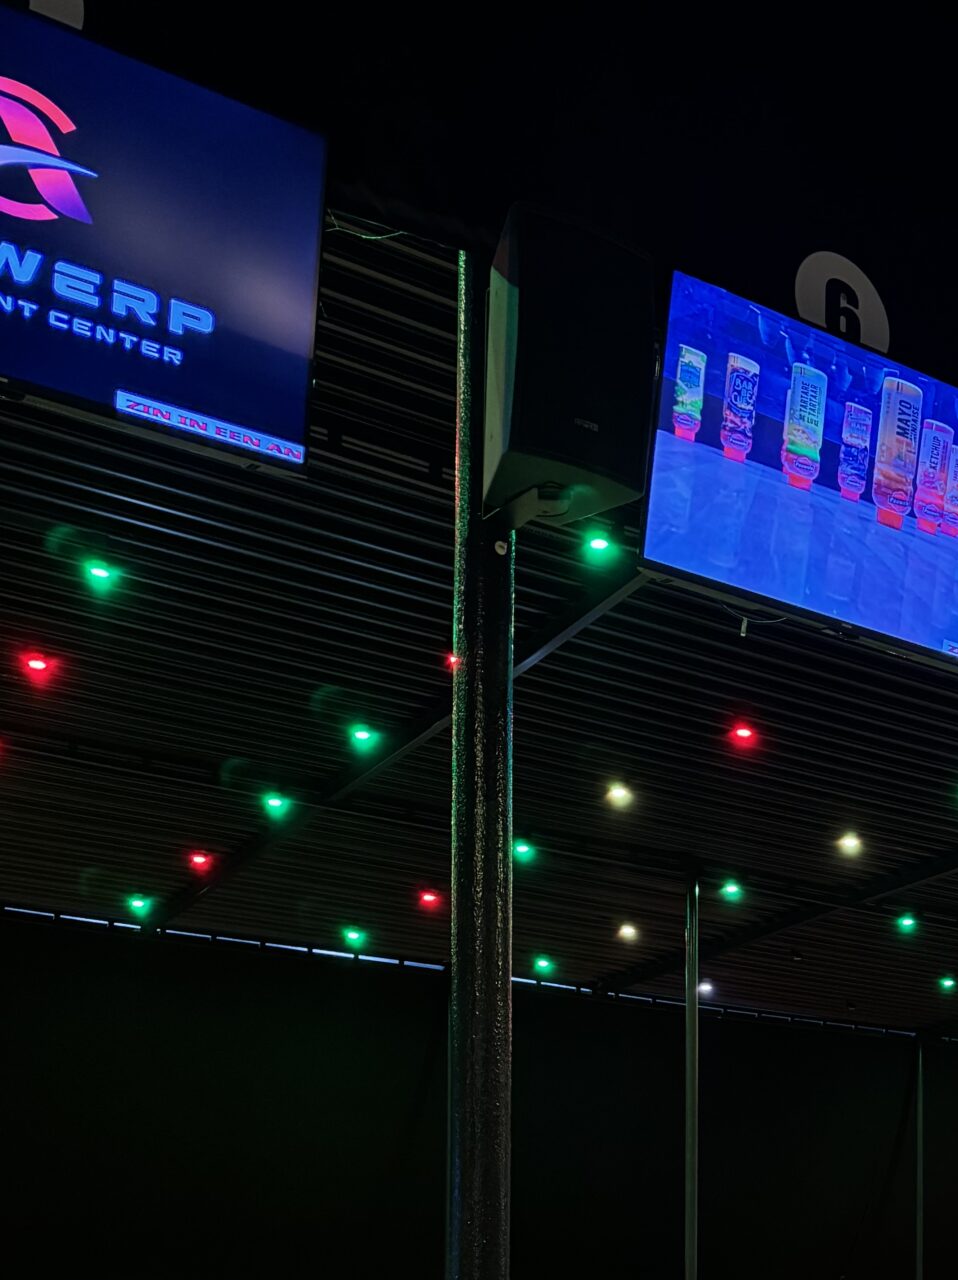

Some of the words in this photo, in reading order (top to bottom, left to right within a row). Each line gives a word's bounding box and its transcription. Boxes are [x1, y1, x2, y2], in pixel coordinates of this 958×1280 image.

[824, 277, 862, 342] 6
[49, 309, 183, 366] CENTER
[126, 398, 171, 421] ZIN
[178, 414, 208, 432] IN
[215, 426, 261, 448] EEN
[895, 399, 912, 440] MAYO
